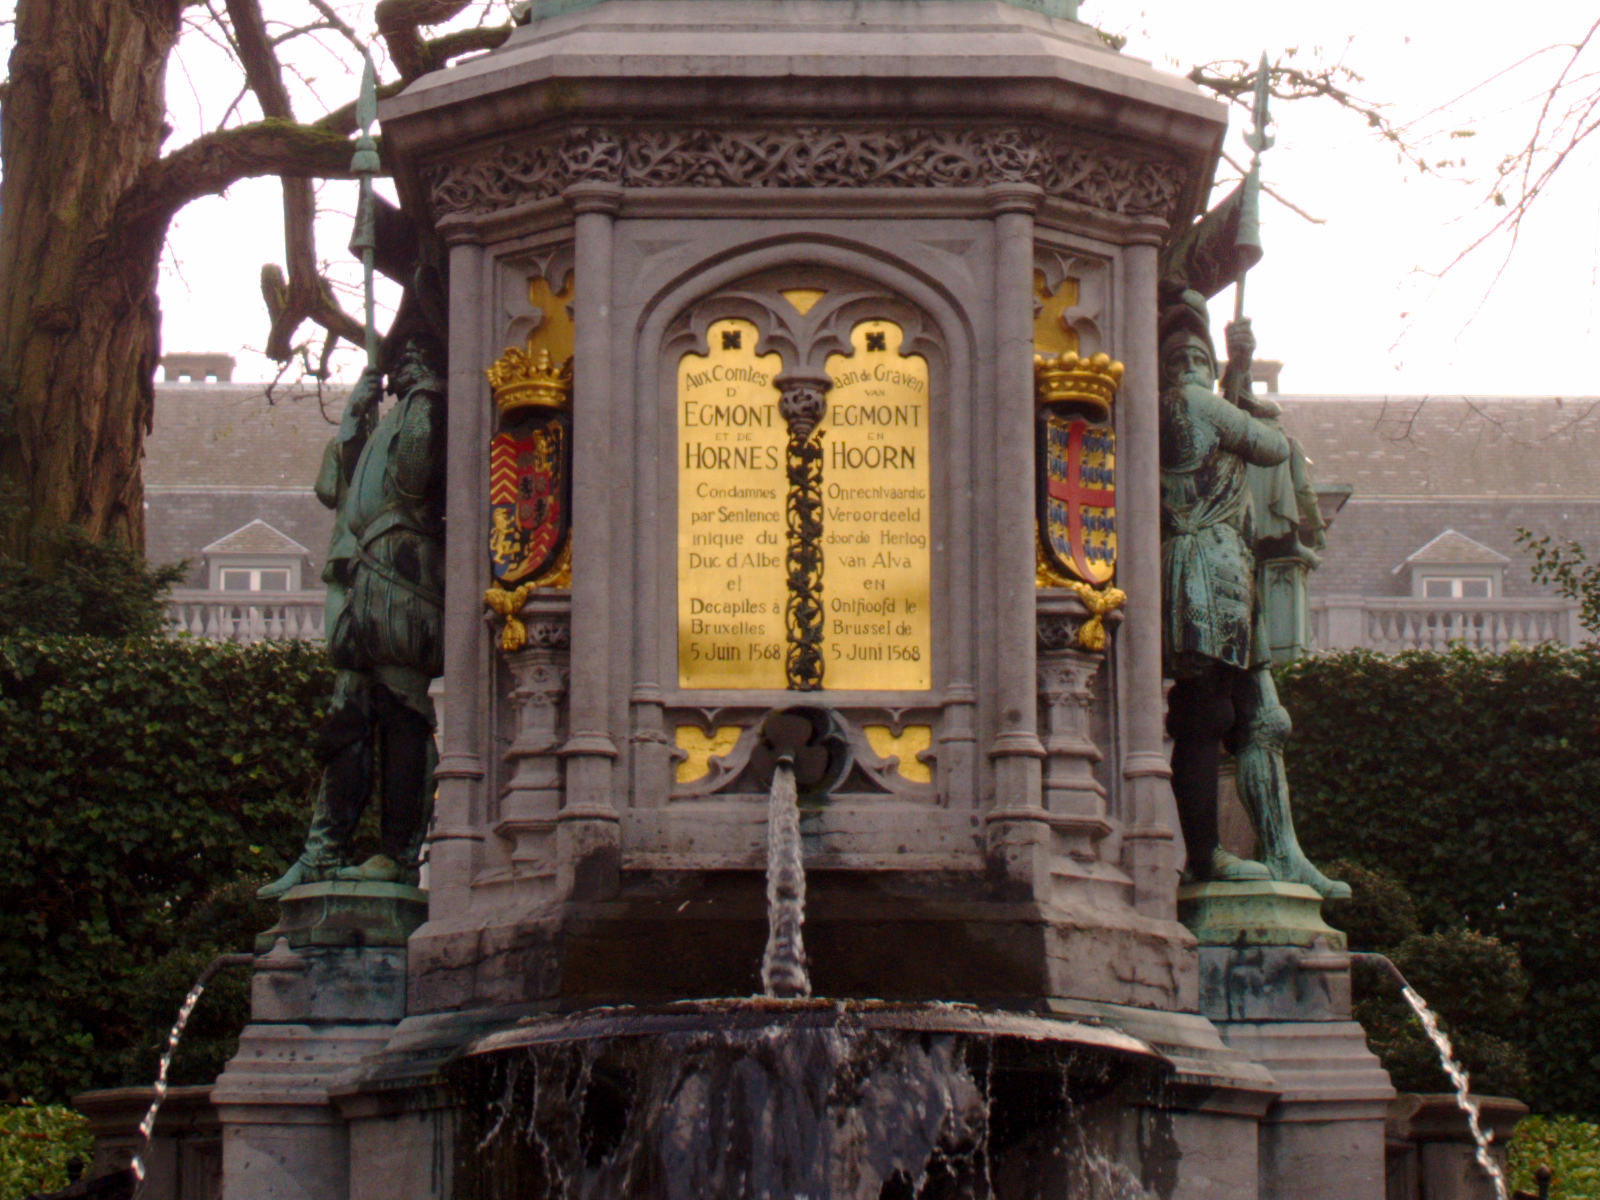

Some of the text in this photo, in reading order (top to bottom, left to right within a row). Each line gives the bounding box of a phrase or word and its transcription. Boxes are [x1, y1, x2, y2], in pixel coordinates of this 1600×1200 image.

[686, 364, 769, 392] Aux Comtes
[860, 369, 872, 382] de
[874, 363, 924, 393] Graven
[865, 389, 885, 397] VAN
[685, 401, 775, 427] EGMONT
[833, 404, 922, 427] EGMONT
[715, 432, 752, 441] ET DE
[867, 432, 884, 441] EN
[685, 442, 778, 470] HORNES
[832, 441, 916, 469] HOORN
[691, 506, 780, 525] par Sentence
[827, 507, 920, 523] Veroordeeld
[692, 530, 778, 549] inique du
[826, 530, 926, 549] door de Hertog
[689, 553, 720, 569] Duc
[839, 551, 912, 569] van Alva
[727, 574, 742, 592] et
[831, 597, 917, 617] Onthoofd te
[691, 618, 765, 635] Bruxelles
[833, 619, 912, 636] Brussel de
[691, 642, 781, 661] 5 Juin 1568
[831, 642, 921, 662] 5 Juni 1568
